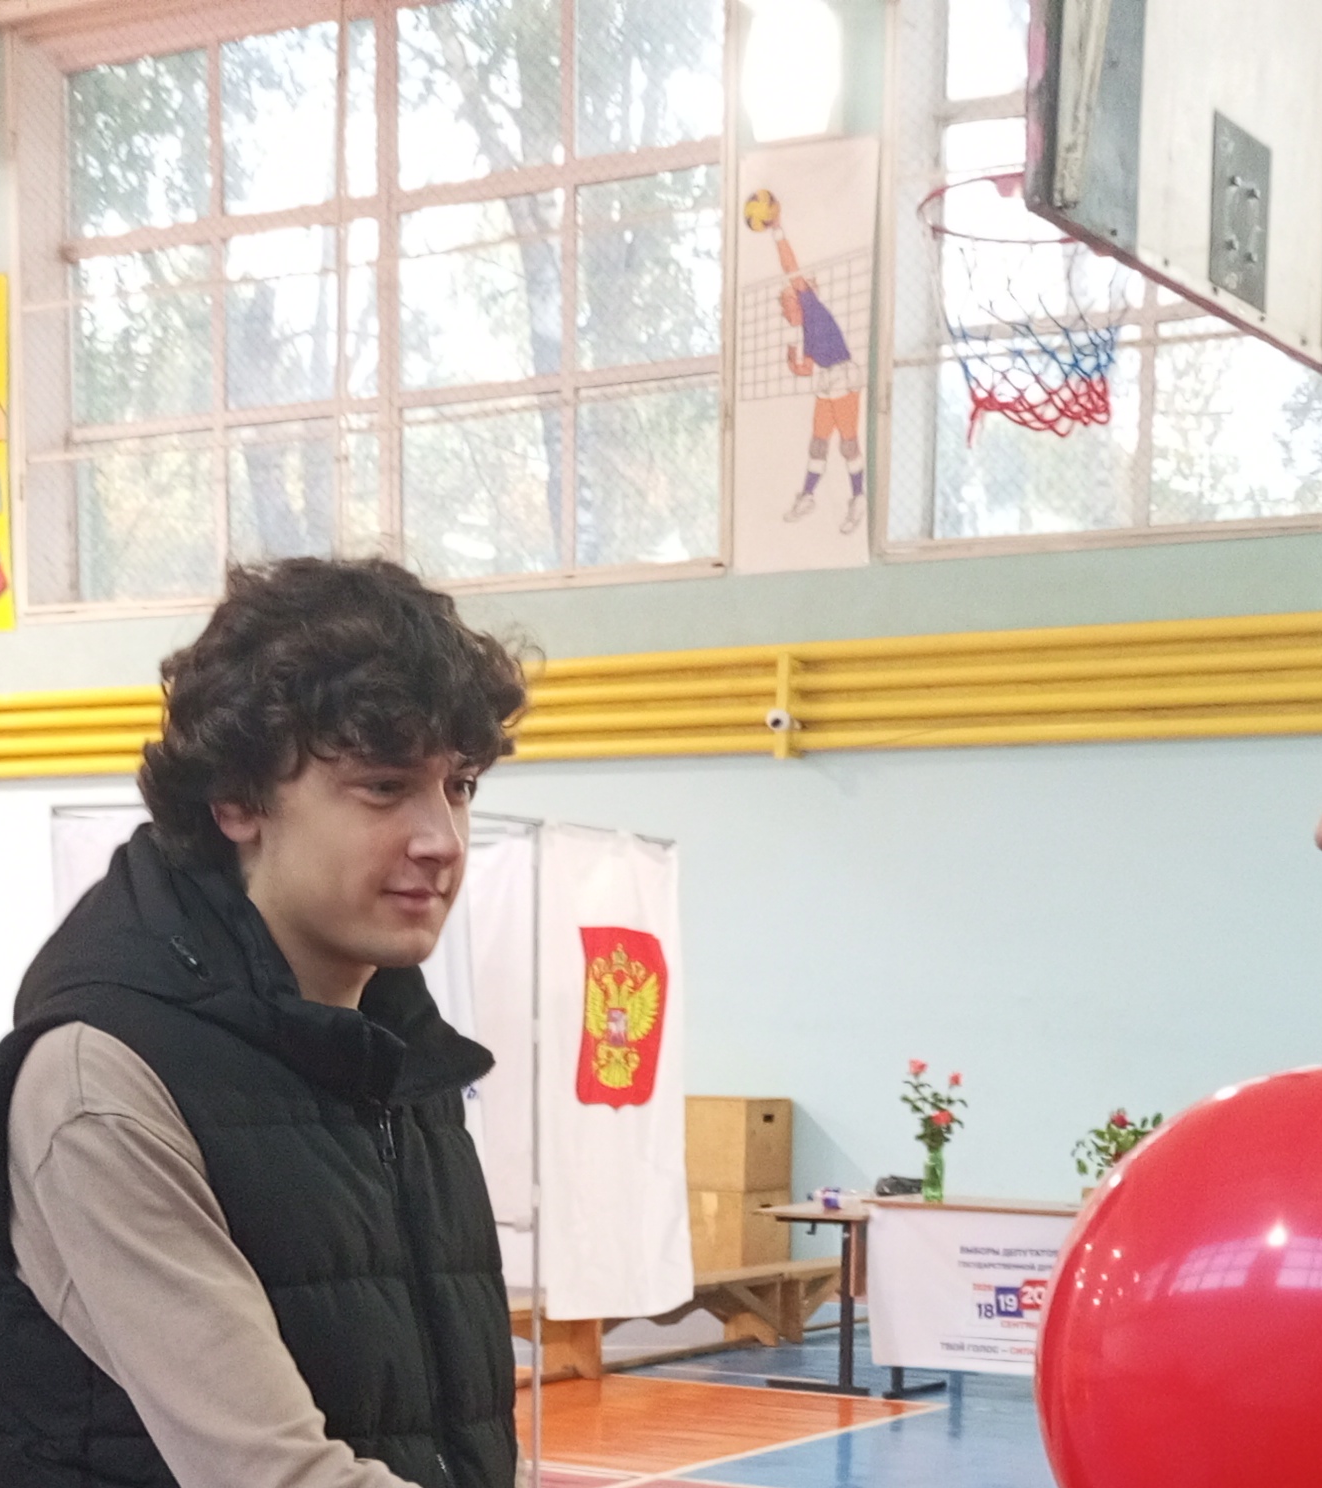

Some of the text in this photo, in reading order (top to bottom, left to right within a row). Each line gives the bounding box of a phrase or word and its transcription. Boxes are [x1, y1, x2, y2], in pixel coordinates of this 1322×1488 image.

[960, 1246, 1000, 1256] ВЫБОРЫ
[976, 1303, 994, 1319] 18
[997, 1293, 1018, 1312] 19
